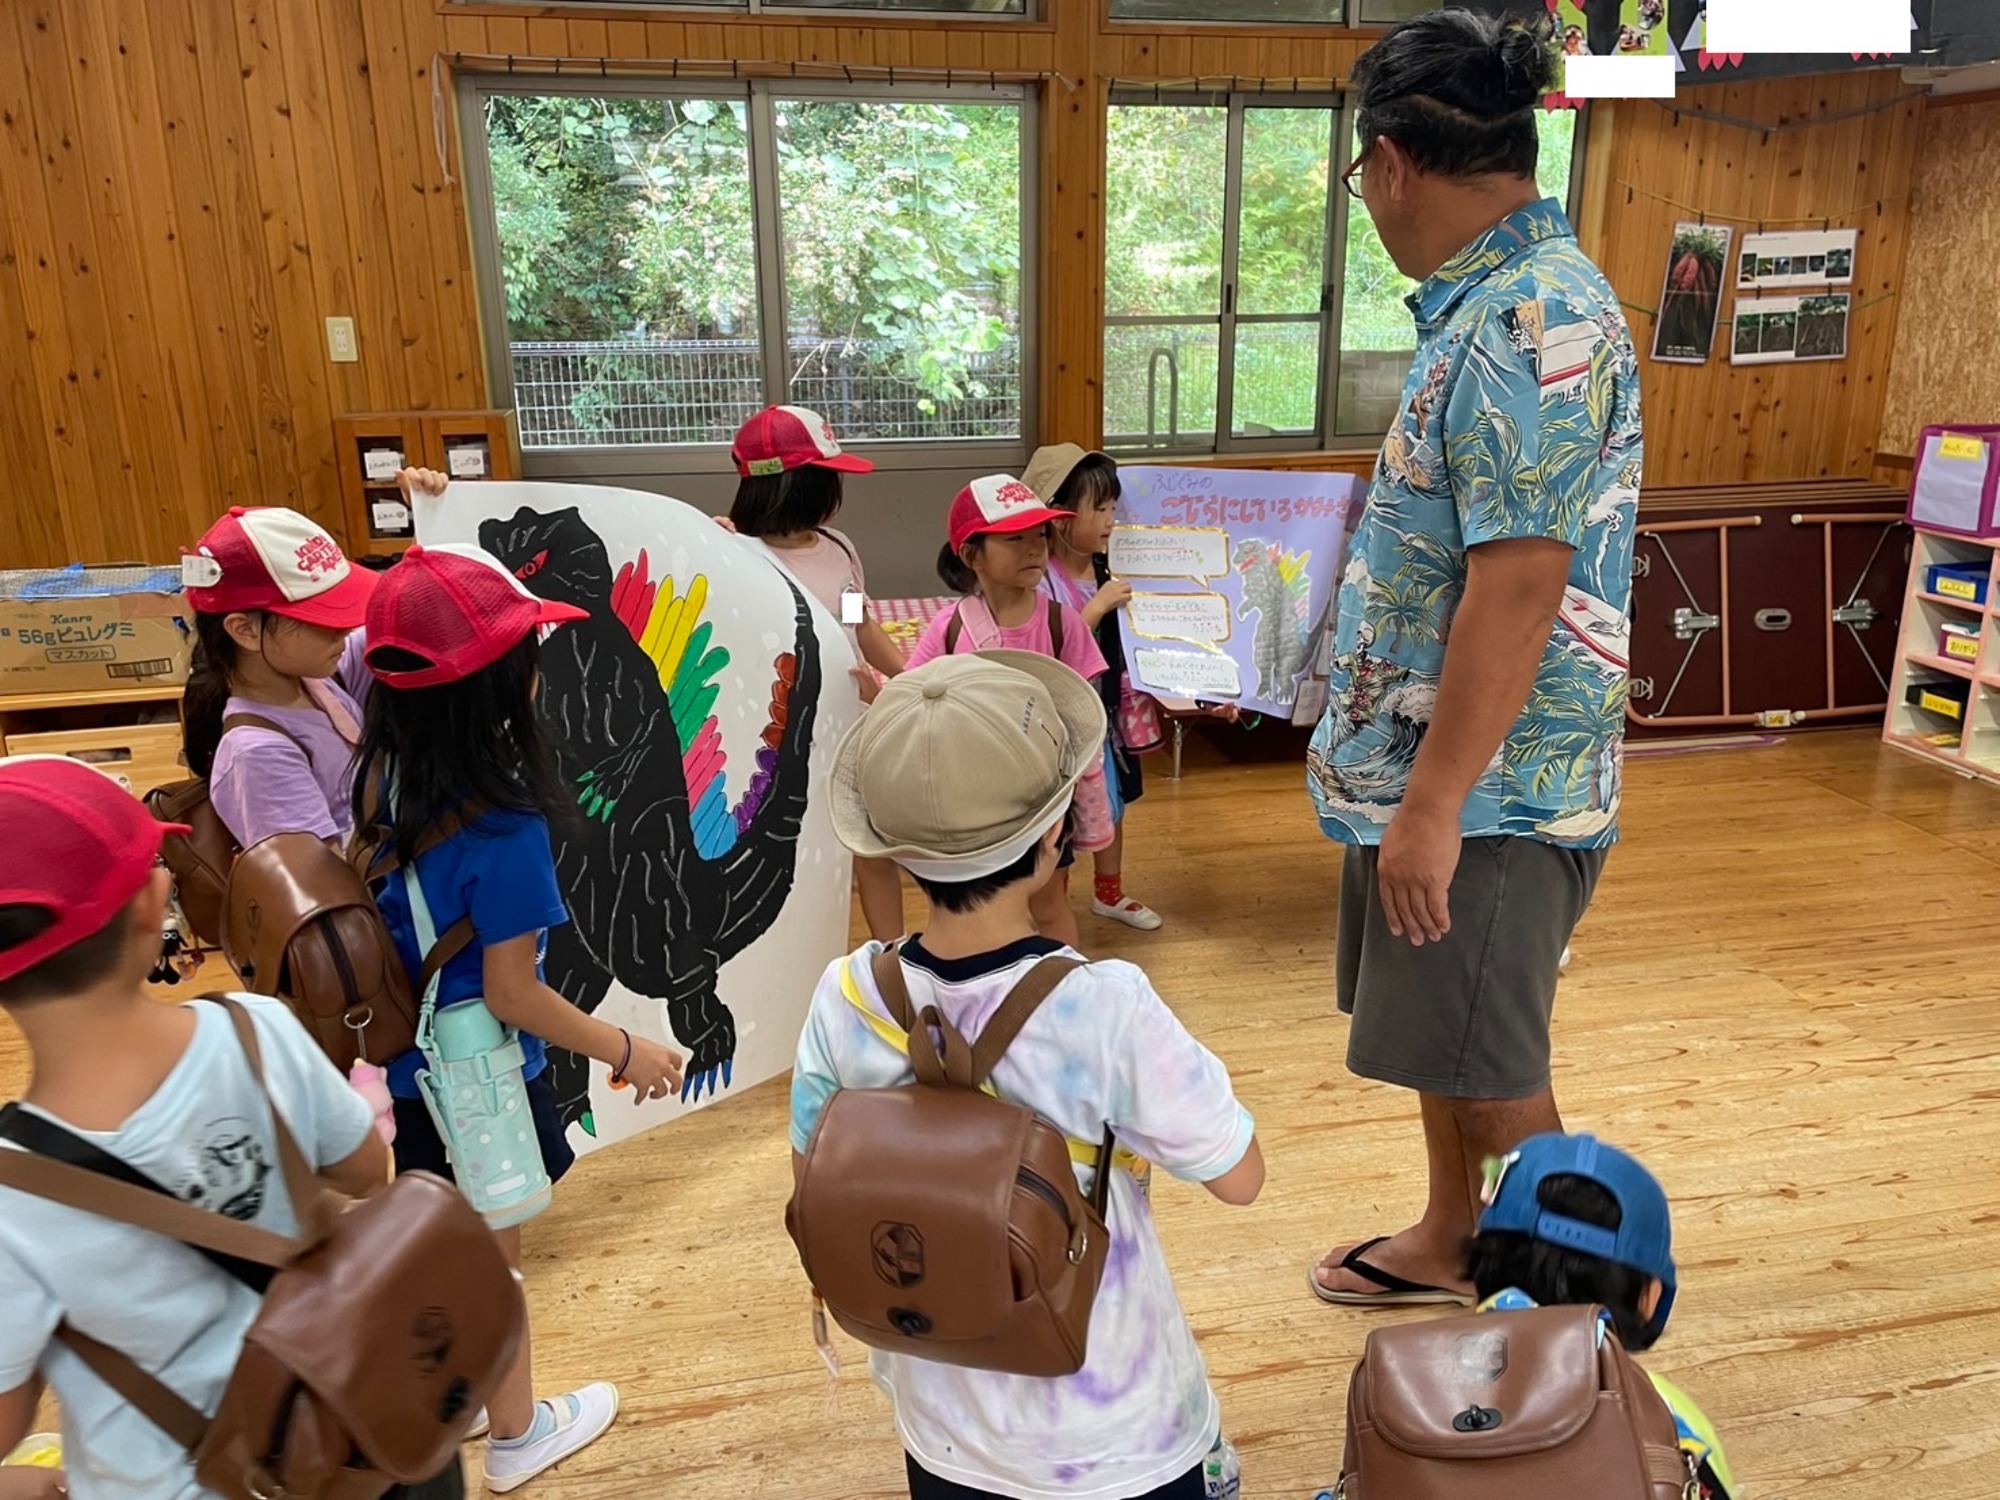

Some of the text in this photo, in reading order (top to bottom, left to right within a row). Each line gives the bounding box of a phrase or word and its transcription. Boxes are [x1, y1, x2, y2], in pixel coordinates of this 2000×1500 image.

[50, 614, 93, 625] Kanro
[18, 622, 136, 646] 56gピュレグミ
[51, 649, 111, 661] マスカット
